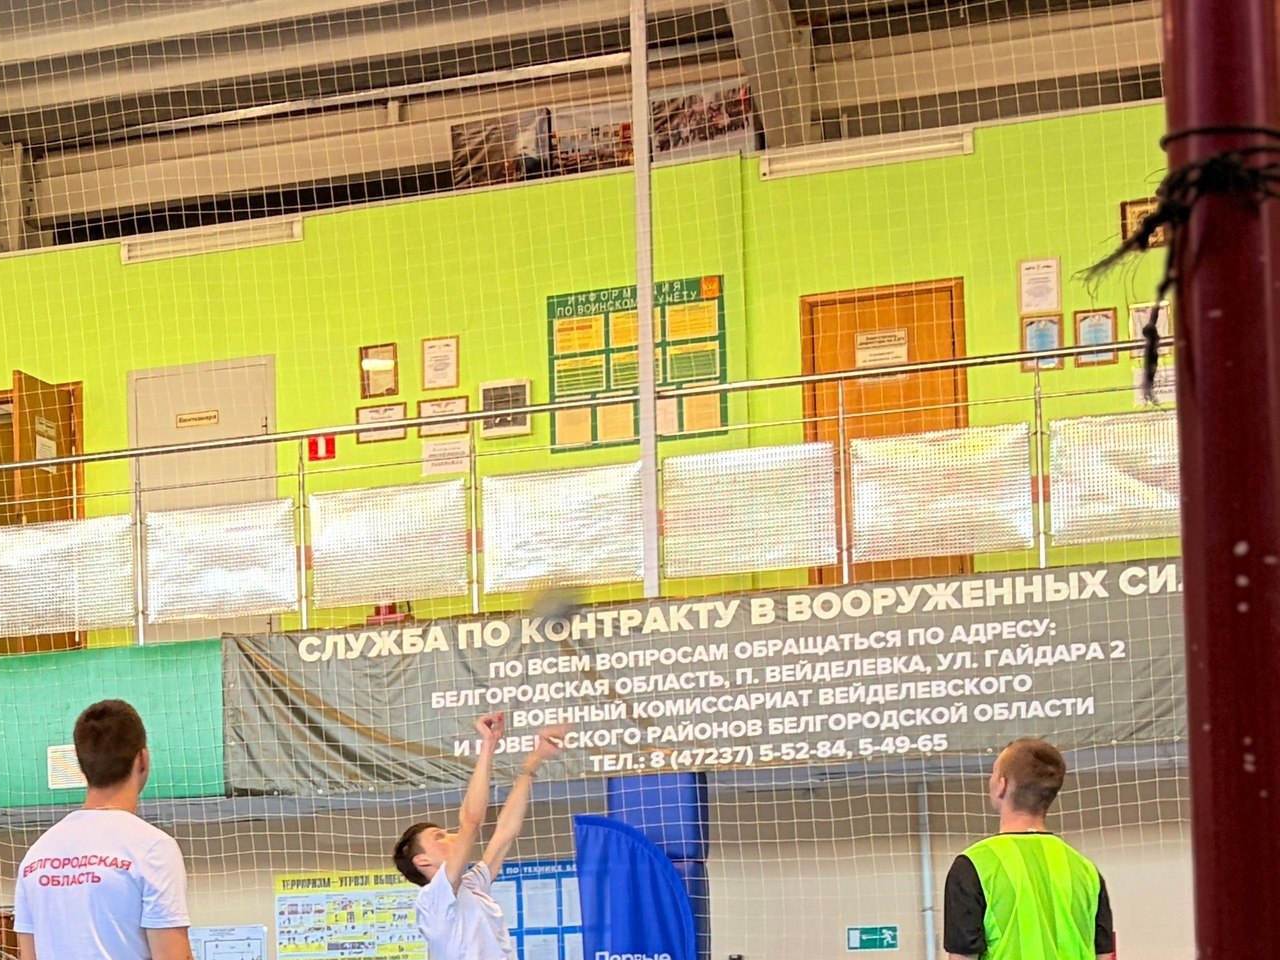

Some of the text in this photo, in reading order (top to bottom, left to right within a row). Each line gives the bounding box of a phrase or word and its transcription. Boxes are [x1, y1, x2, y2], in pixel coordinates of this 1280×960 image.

[557, 306, 573, 318] ПО
[298, 564, 1183, 662] СЛУЖБА ПО КОНТРАКТУ В ВООРУЖЕННЫХ СИ
[489, 618, 1057, 680] ПО ВСЕМ ВОПРОСАМ ОБРАЩАТЬСЯ ПО АДРЕСУ:
[431, 640, 1127, 709] БЕЛГОРОДСКАЯ ОБЛАСТЬ, П. ВЕЙДЕЛЕВКА, УЛ. ГАЙДАРА 2
[513, 673, 1032, 728] ВОЕННЫЙ КОМИССАРИАТ ВЕЙДЕЛЕВСКОГО
[454, 740, 470, 757] И
[646, 719, 762, 745] РАЙОНОВ
[768, 704, 968, 736] БЕЛГОРОДСКОЙ
[974, 697, 1095, 723] ОБЛАСТИ
[590, 732, 949, 773] ТЕЛ.: 8 (47237) 5-52-84, 5-49-65
[23, 854, 132, 878] БЕЛГОРОДСКАЯ
[38, 872, 101, 887] ОБЛАСТЬ
[282, 877, 331, 890] ТЕРРОРИЗМ
[339, 874, 369, 887] УГРОЗА
